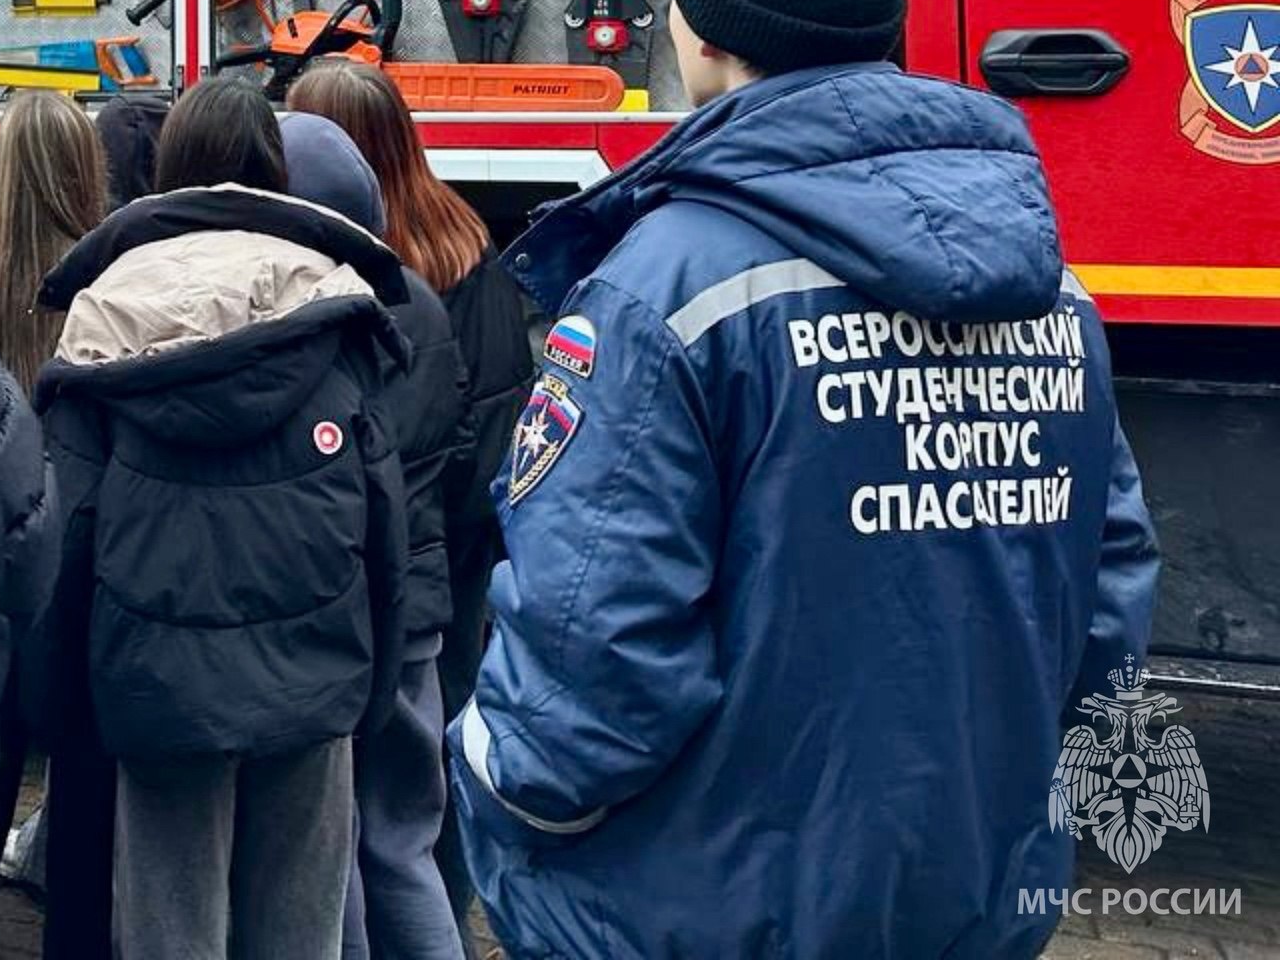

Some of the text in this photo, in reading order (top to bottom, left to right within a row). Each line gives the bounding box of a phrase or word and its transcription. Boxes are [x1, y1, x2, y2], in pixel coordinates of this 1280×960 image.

[513, 84, 569, 95] PATRIOT
[817, 357, 1085, 424] СТУДЕНЧЕСКИЙ
[905, 420, 1041, 471] КОРПУС
